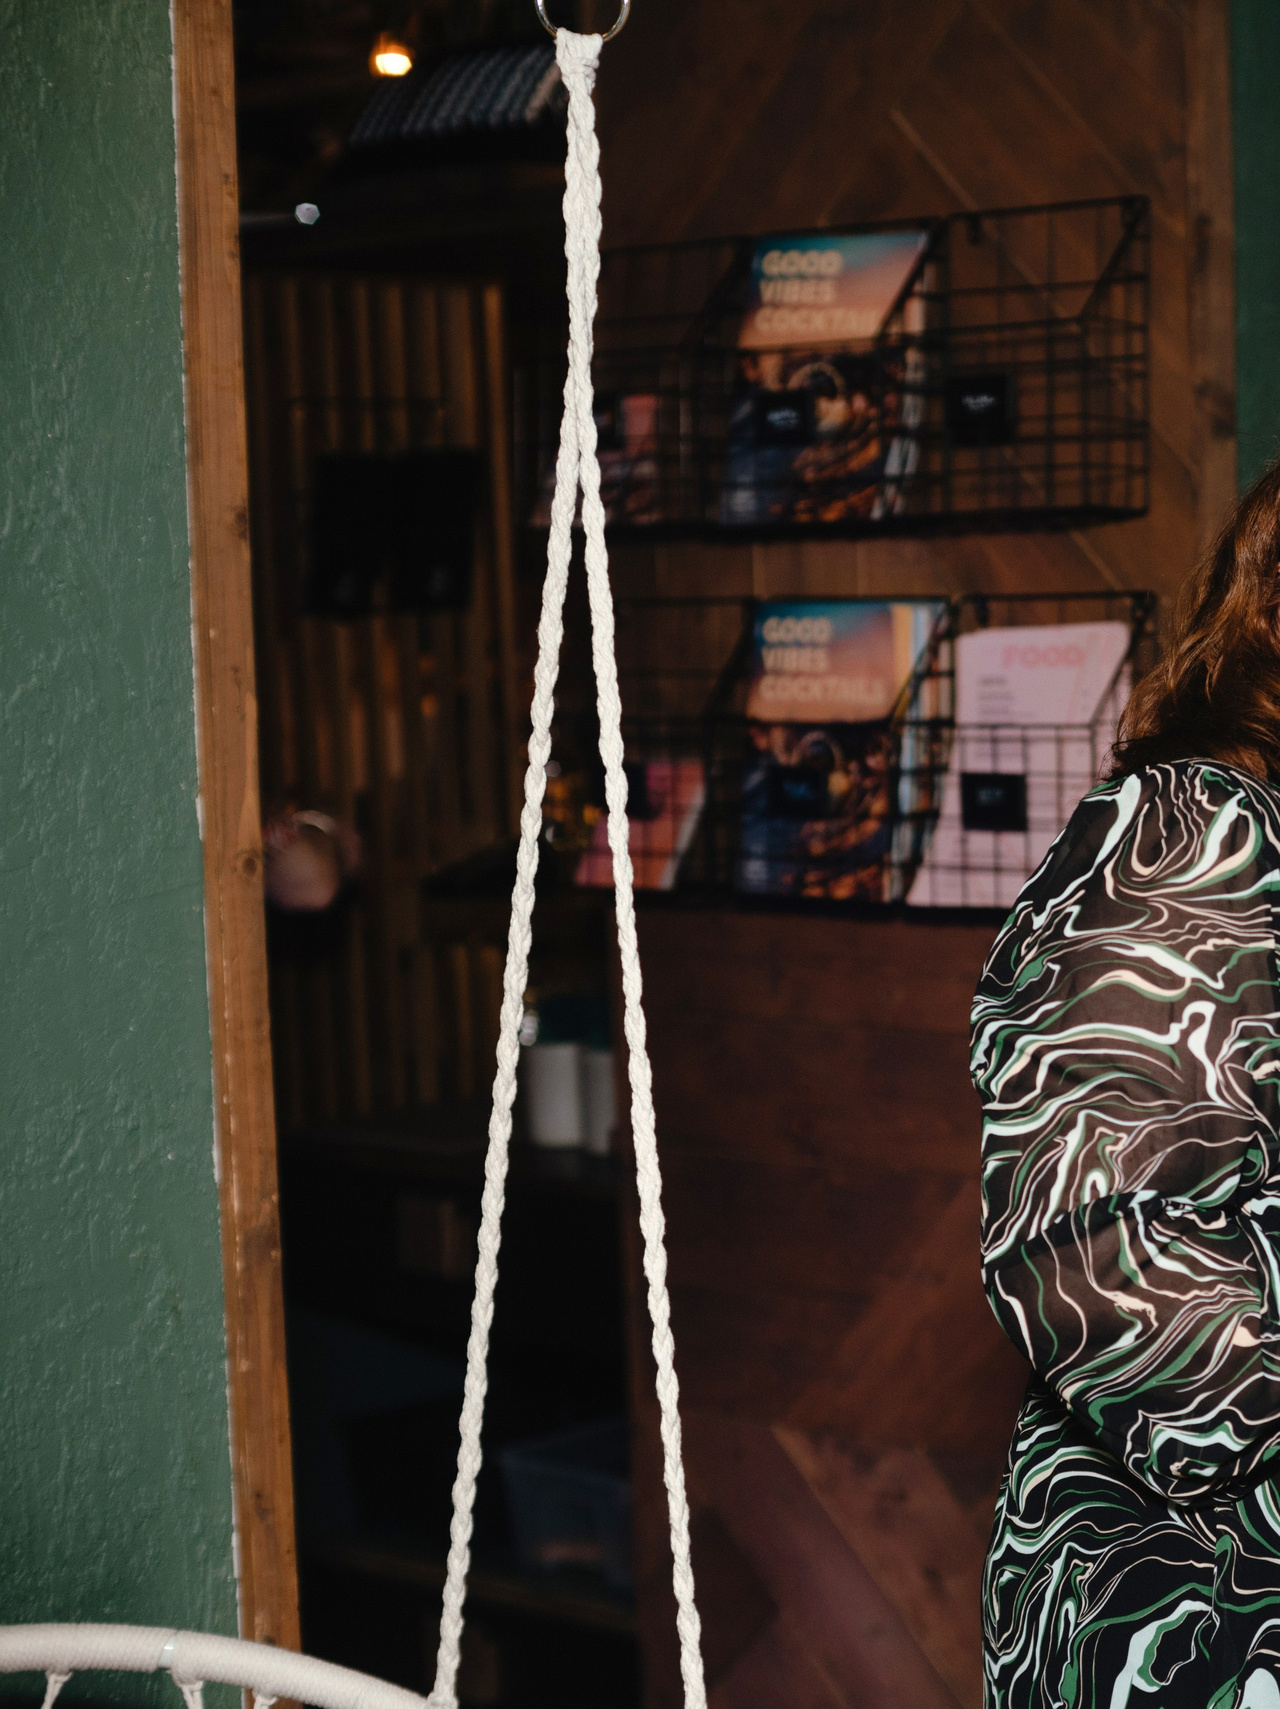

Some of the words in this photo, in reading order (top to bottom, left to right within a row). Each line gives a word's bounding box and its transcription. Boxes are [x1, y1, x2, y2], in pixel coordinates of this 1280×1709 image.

[762, 249, 844, 276] GOOD
[762, 616, 834, 644] GOOD
[1002, 643, 1087, 669] FOOD
